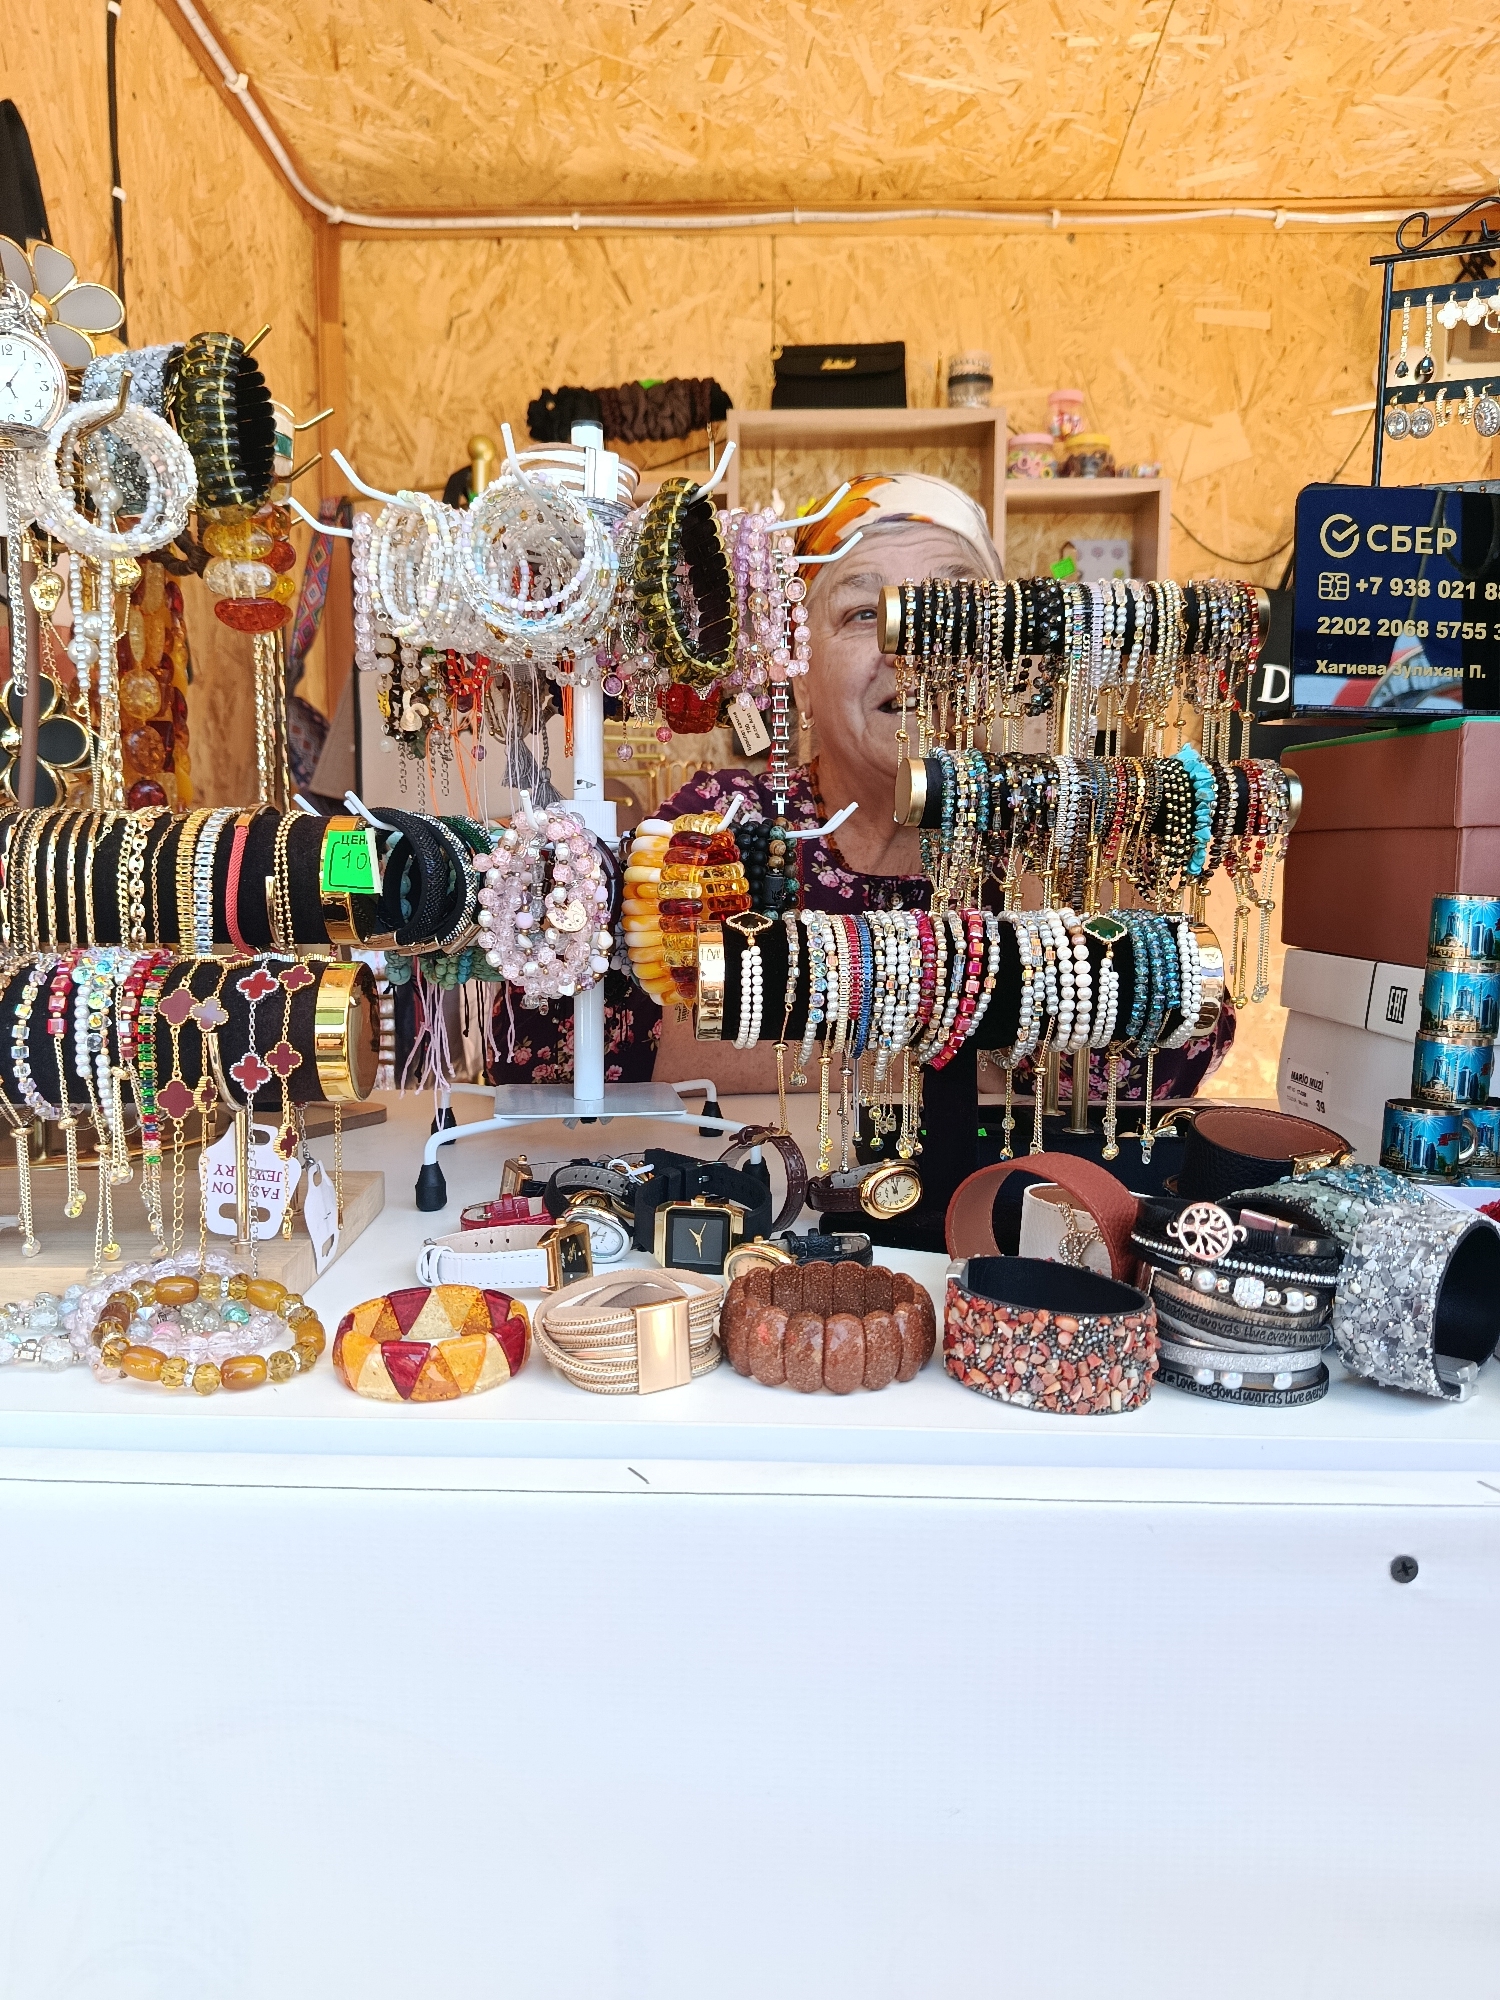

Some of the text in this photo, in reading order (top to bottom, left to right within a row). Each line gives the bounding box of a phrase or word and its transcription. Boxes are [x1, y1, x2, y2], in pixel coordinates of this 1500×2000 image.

[39, 380, 50, 392] 3
[34, 398, 45, 410] 4
[23, 409, 33, 422] 5
[1366, 524, 1458, 555] СБЕР
[1355, 577, 1384, 595] +7
[1390, 578, 1431, 598] 938
[1437, 579, 1476, 600] 021
[1316, 616, 1371, 636] 2202
[1376, 618, 1429, 638] 2068
[1435, 621, 1487, 640] 5755
[1315, 659, 1387, 675] Хагиева
[1469, 664, 1486, 679] П.
[341, 834, 369, 847] ЦЕН
[1315, 1099, 1326, 1114] 39
[1176, 1374, 1197, 1391] love
[1243, 1390, 1283, 1405] words
